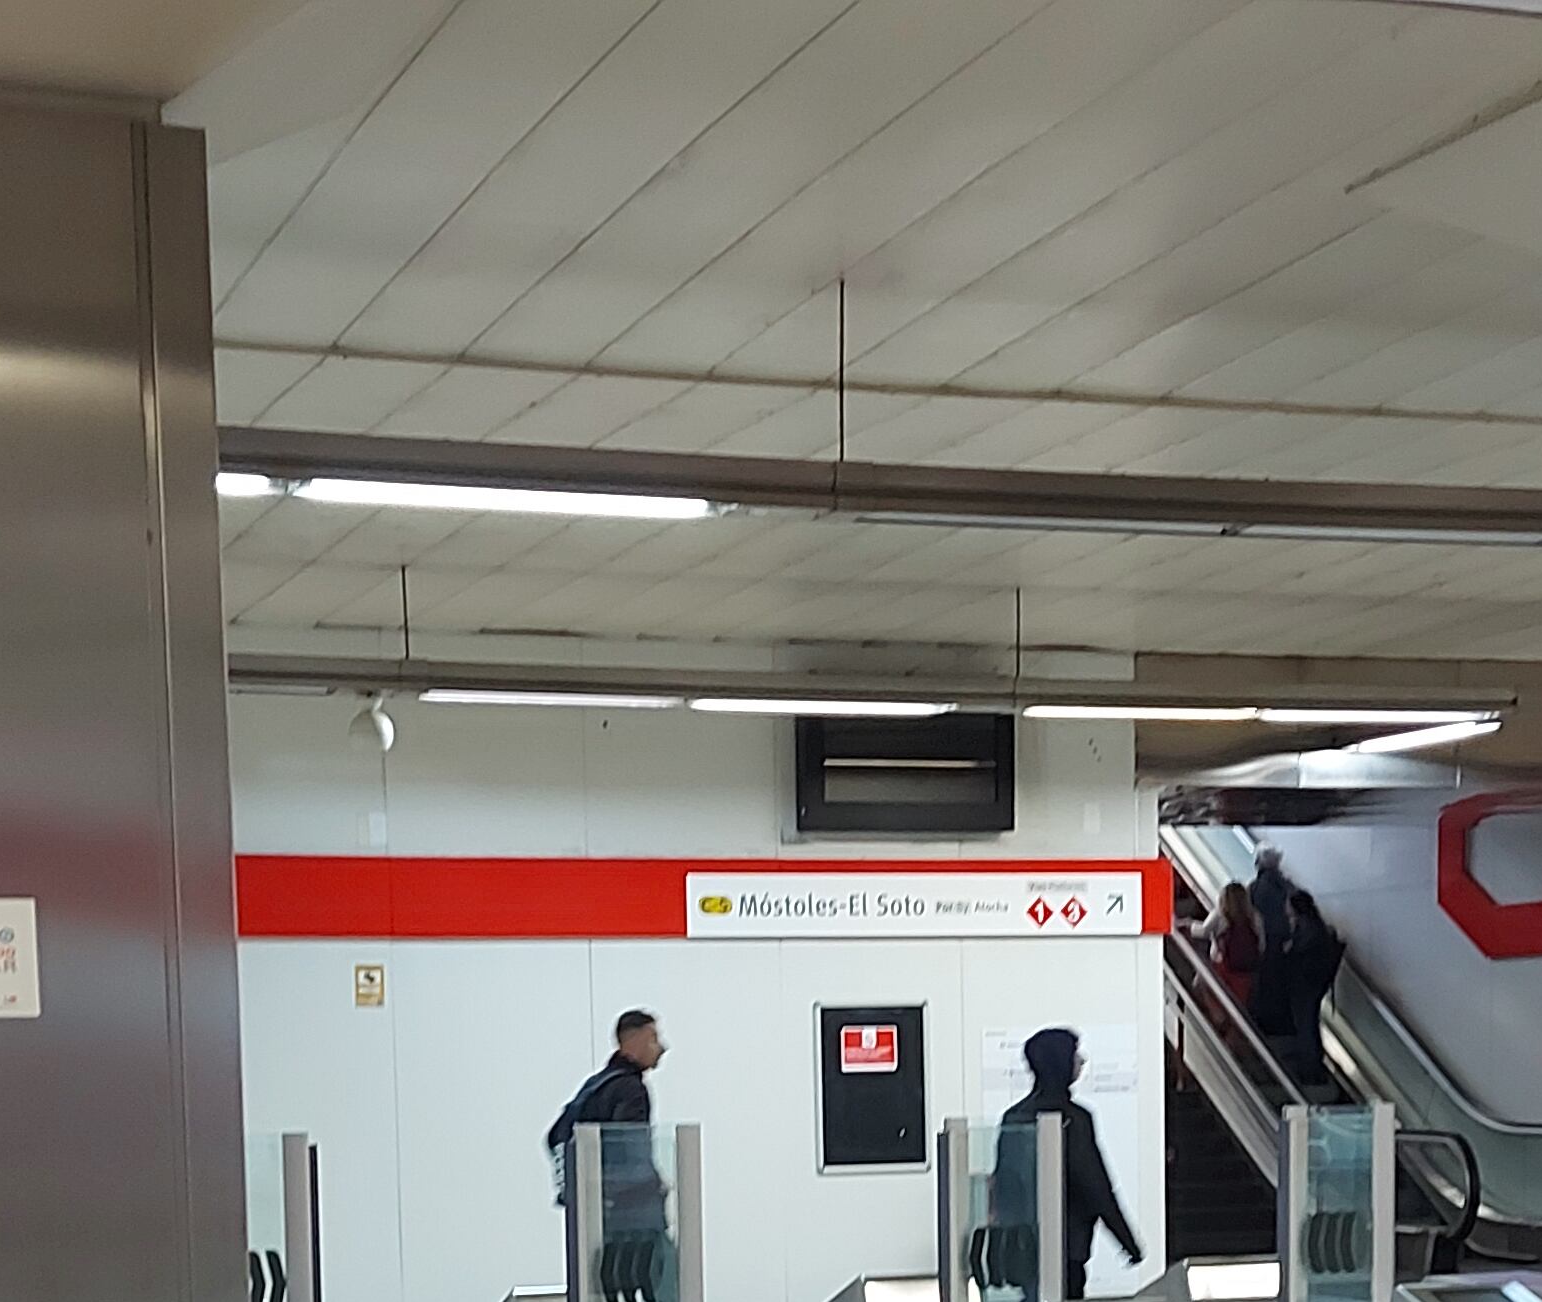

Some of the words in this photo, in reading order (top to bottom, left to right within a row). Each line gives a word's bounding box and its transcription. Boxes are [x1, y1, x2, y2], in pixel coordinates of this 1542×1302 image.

[738, 891, 868, 918] Móstoles-El
[876, 893, 926, 918] Soto
[1034, 900, 1045, 923] 1
